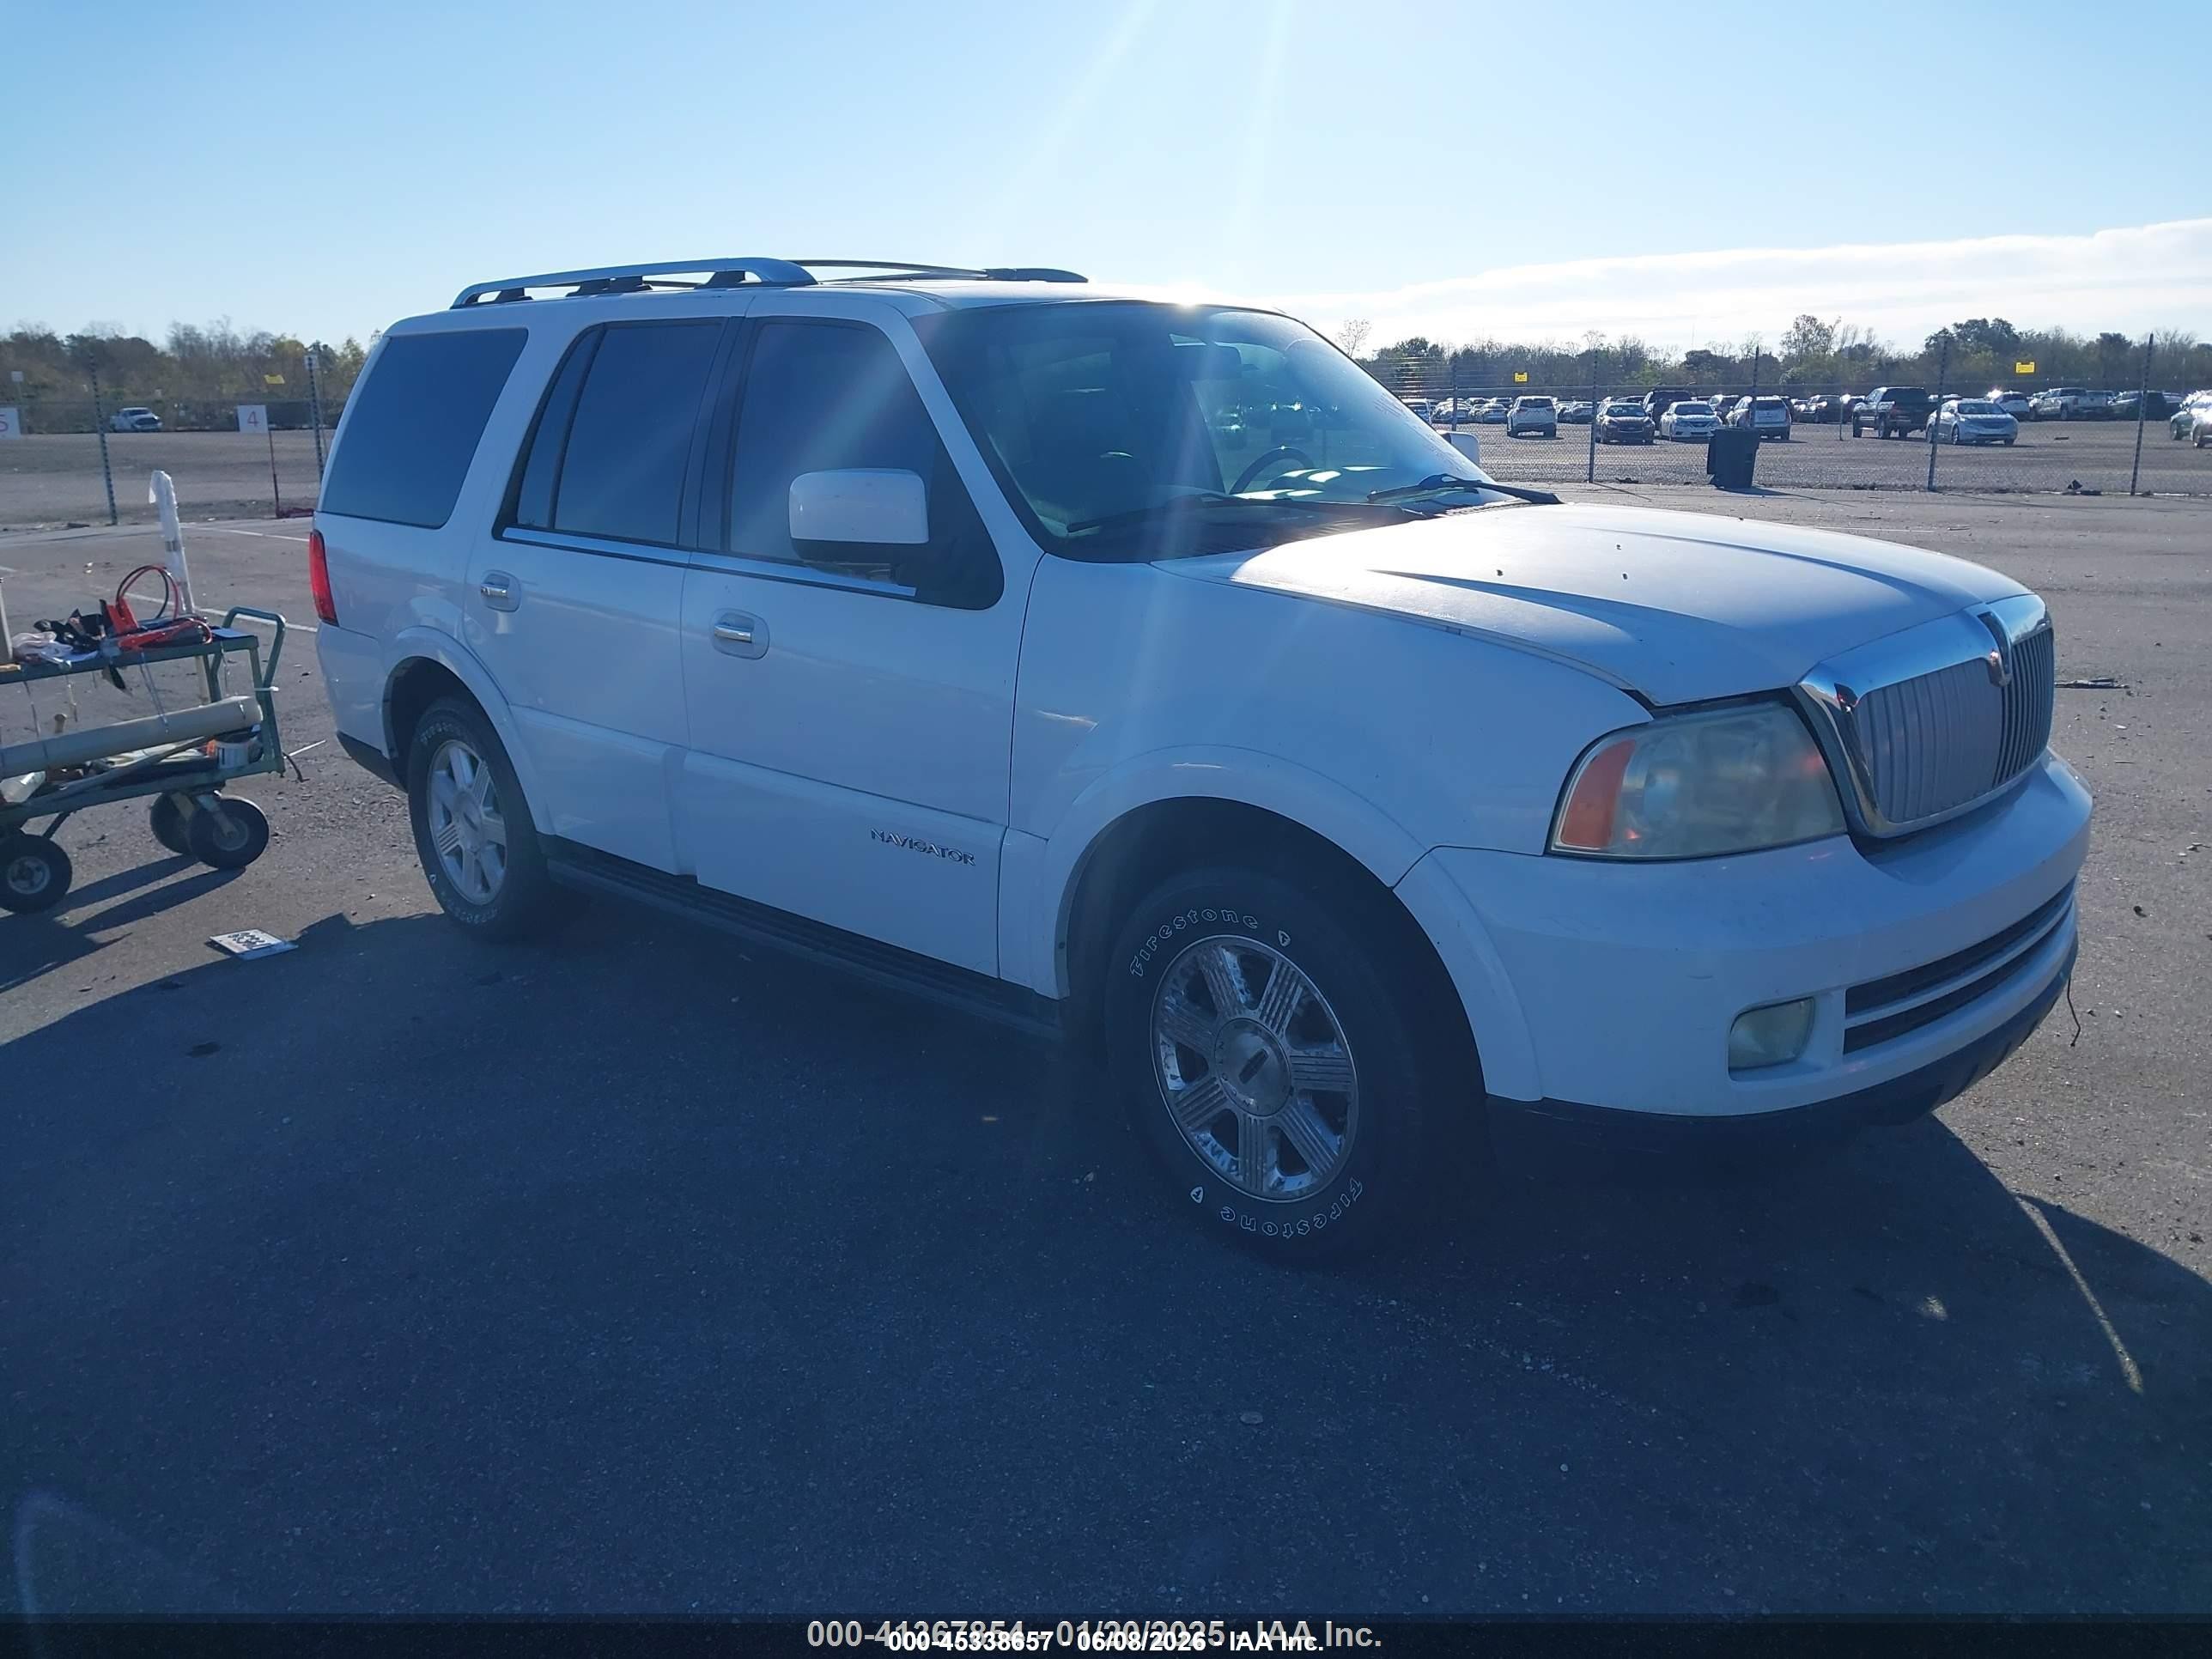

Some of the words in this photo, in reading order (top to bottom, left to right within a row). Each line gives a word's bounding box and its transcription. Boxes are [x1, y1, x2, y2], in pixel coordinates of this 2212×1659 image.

[247, 410, 260, 427] 4
[870, 828, 976, 866] NAVIGATOR
[1129, 908, 1259, 977] Firestone
[1220, 1177, 1364, 1240] Firestone
